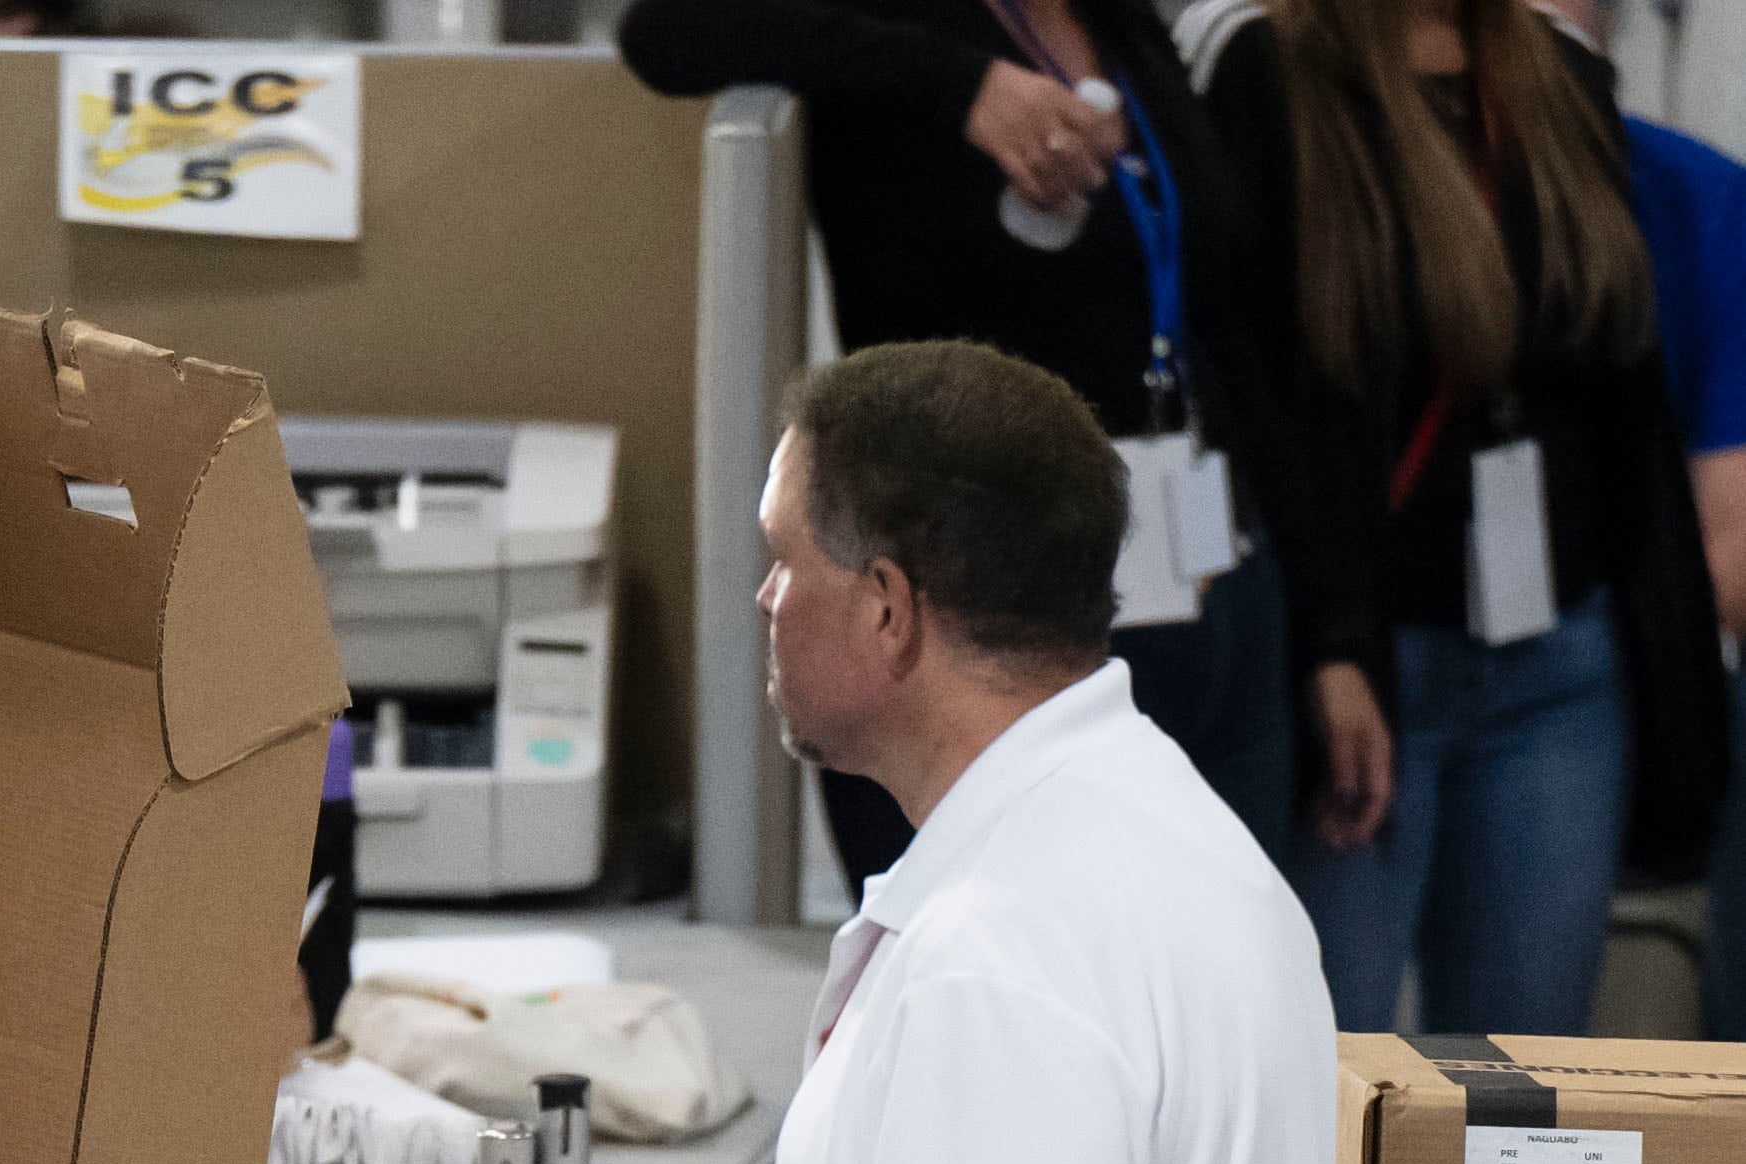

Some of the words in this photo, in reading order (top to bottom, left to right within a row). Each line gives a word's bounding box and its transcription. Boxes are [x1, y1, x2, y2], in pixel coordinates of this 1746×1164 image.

[111, 68, 300, 117] ICC
[179, 158, 233, 201] 5
[1500, 1150, 1518, 1158] PRE
[1584, 1152, 1602, 1161] UNI
